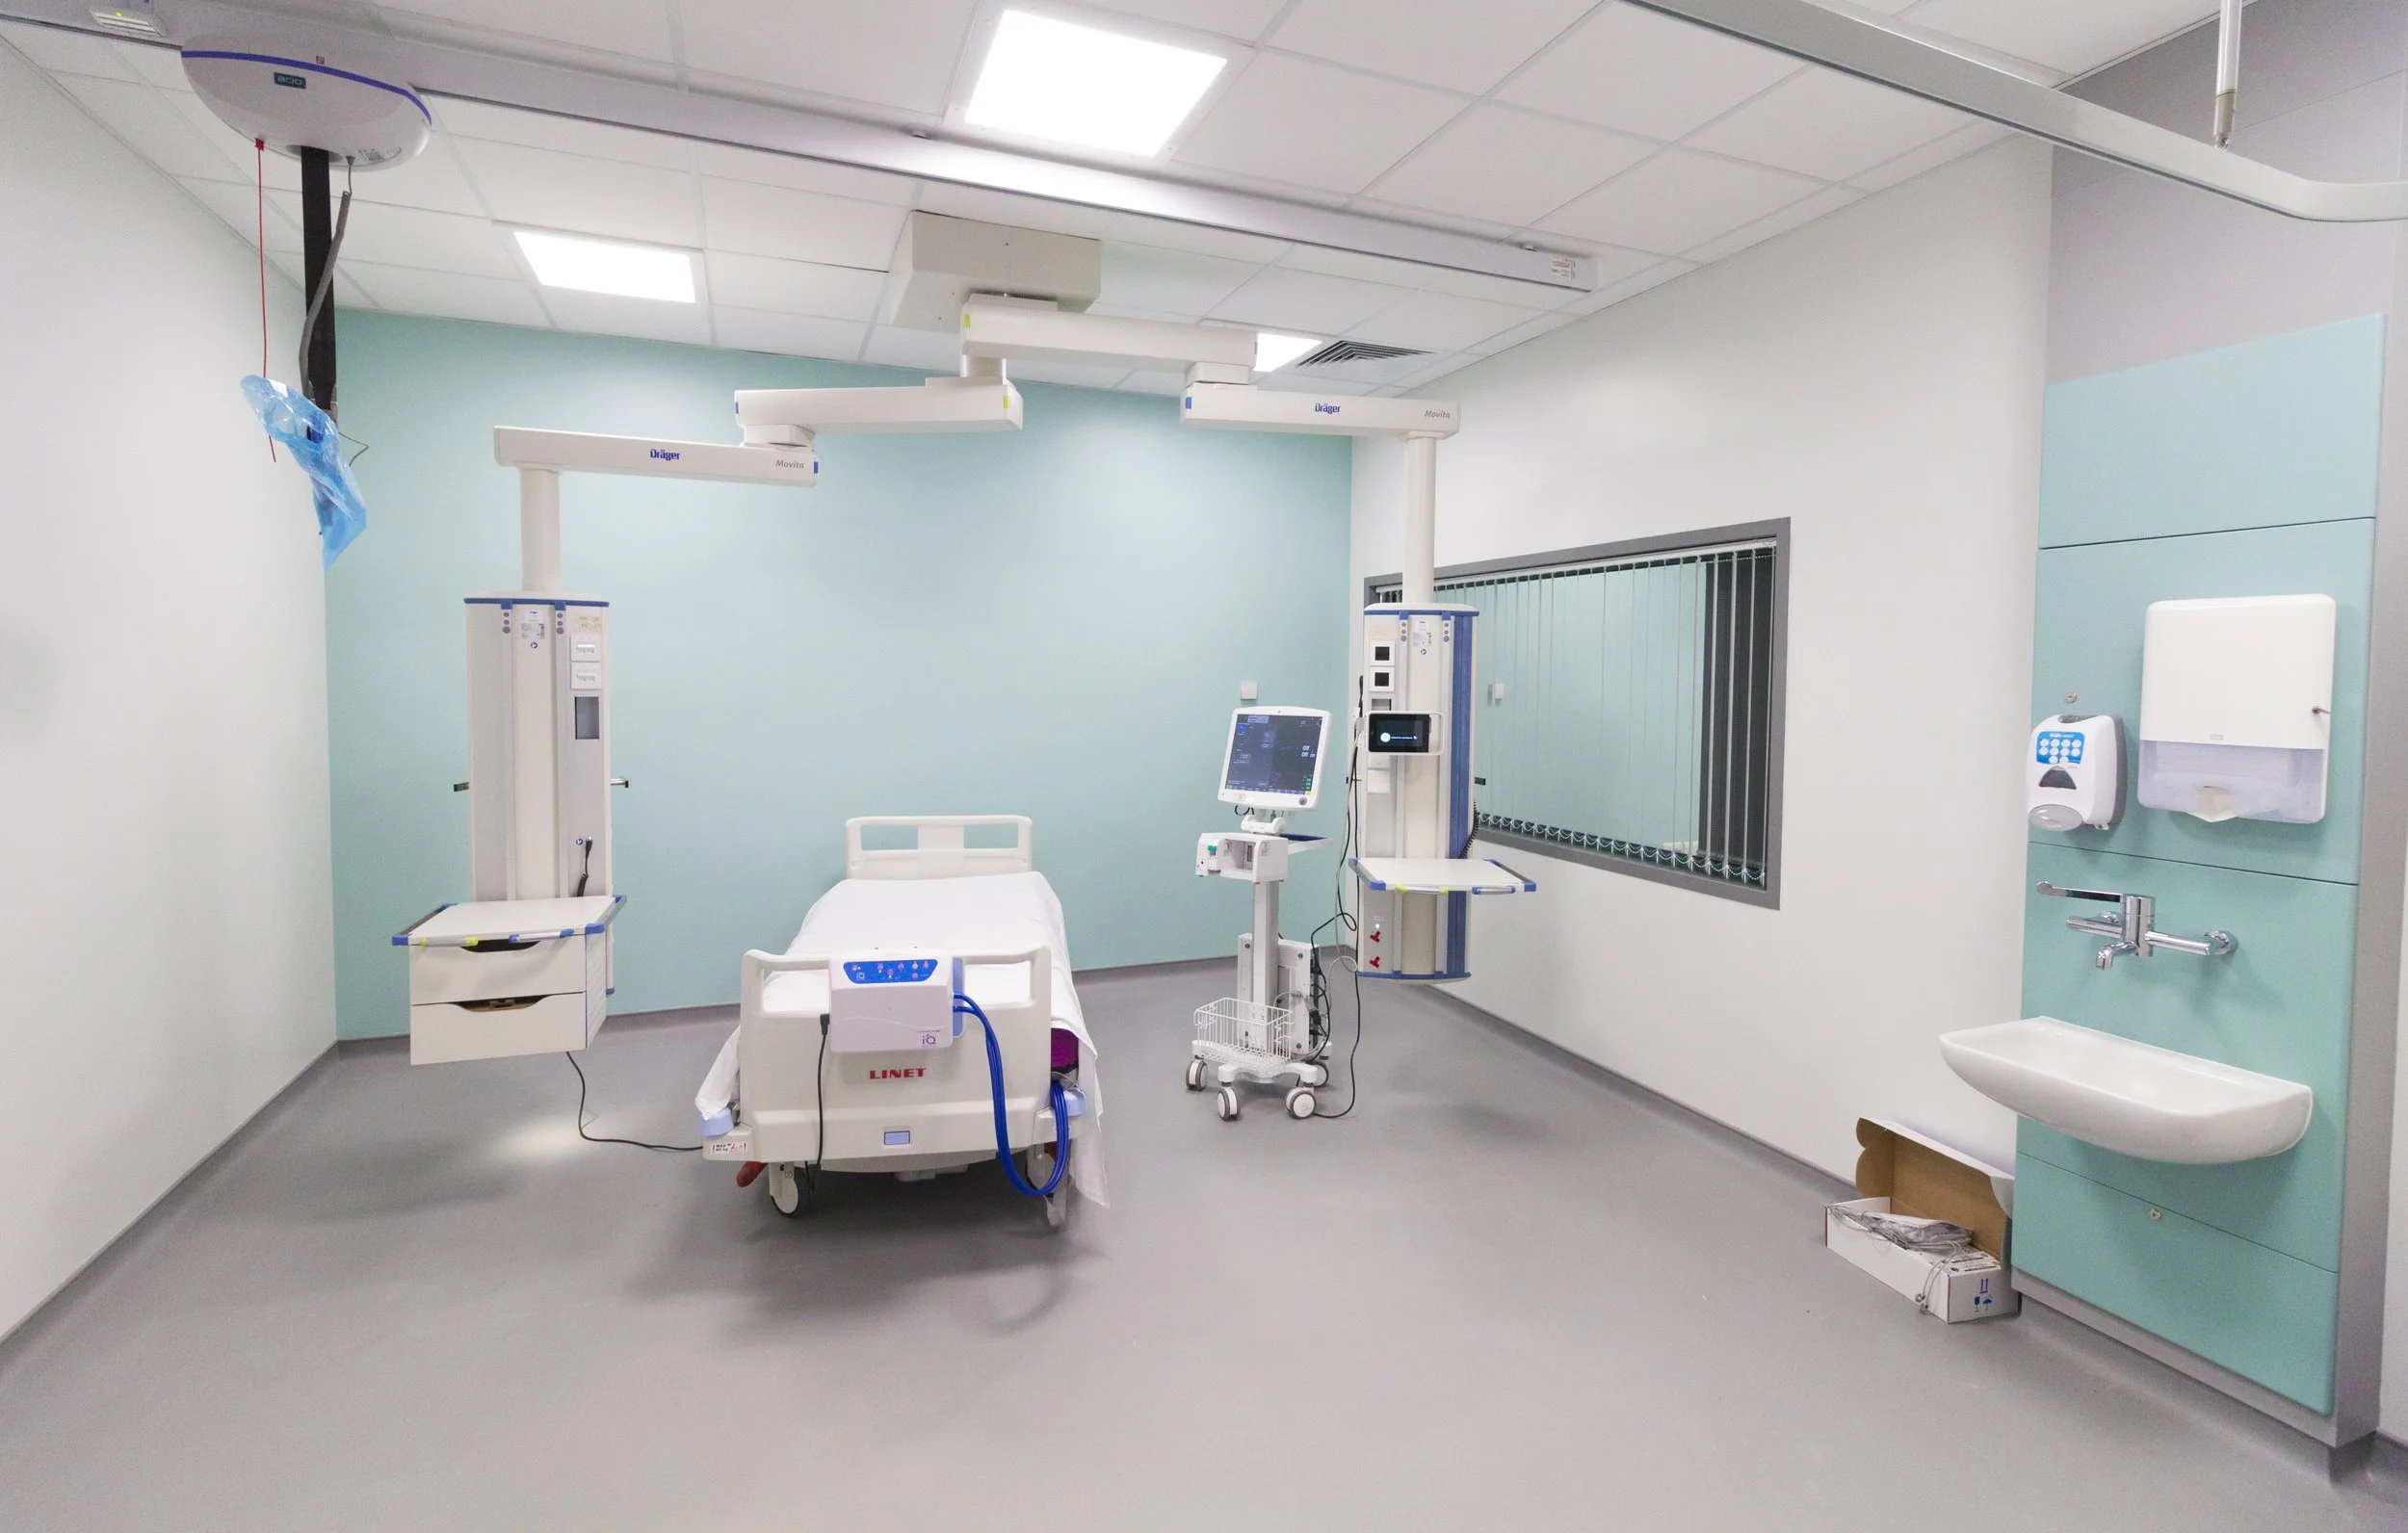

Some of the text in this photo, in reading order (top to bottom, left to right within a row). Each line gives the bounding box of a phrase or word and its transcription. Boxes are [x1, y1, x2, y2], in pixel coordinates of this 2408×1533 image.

[1315, 403, 1341, 414] Dräger
[650, 449, 680, 461] Dräger
[776, 459, 804, 469] Movita
[870, 1068, 927, 1079] LINET
